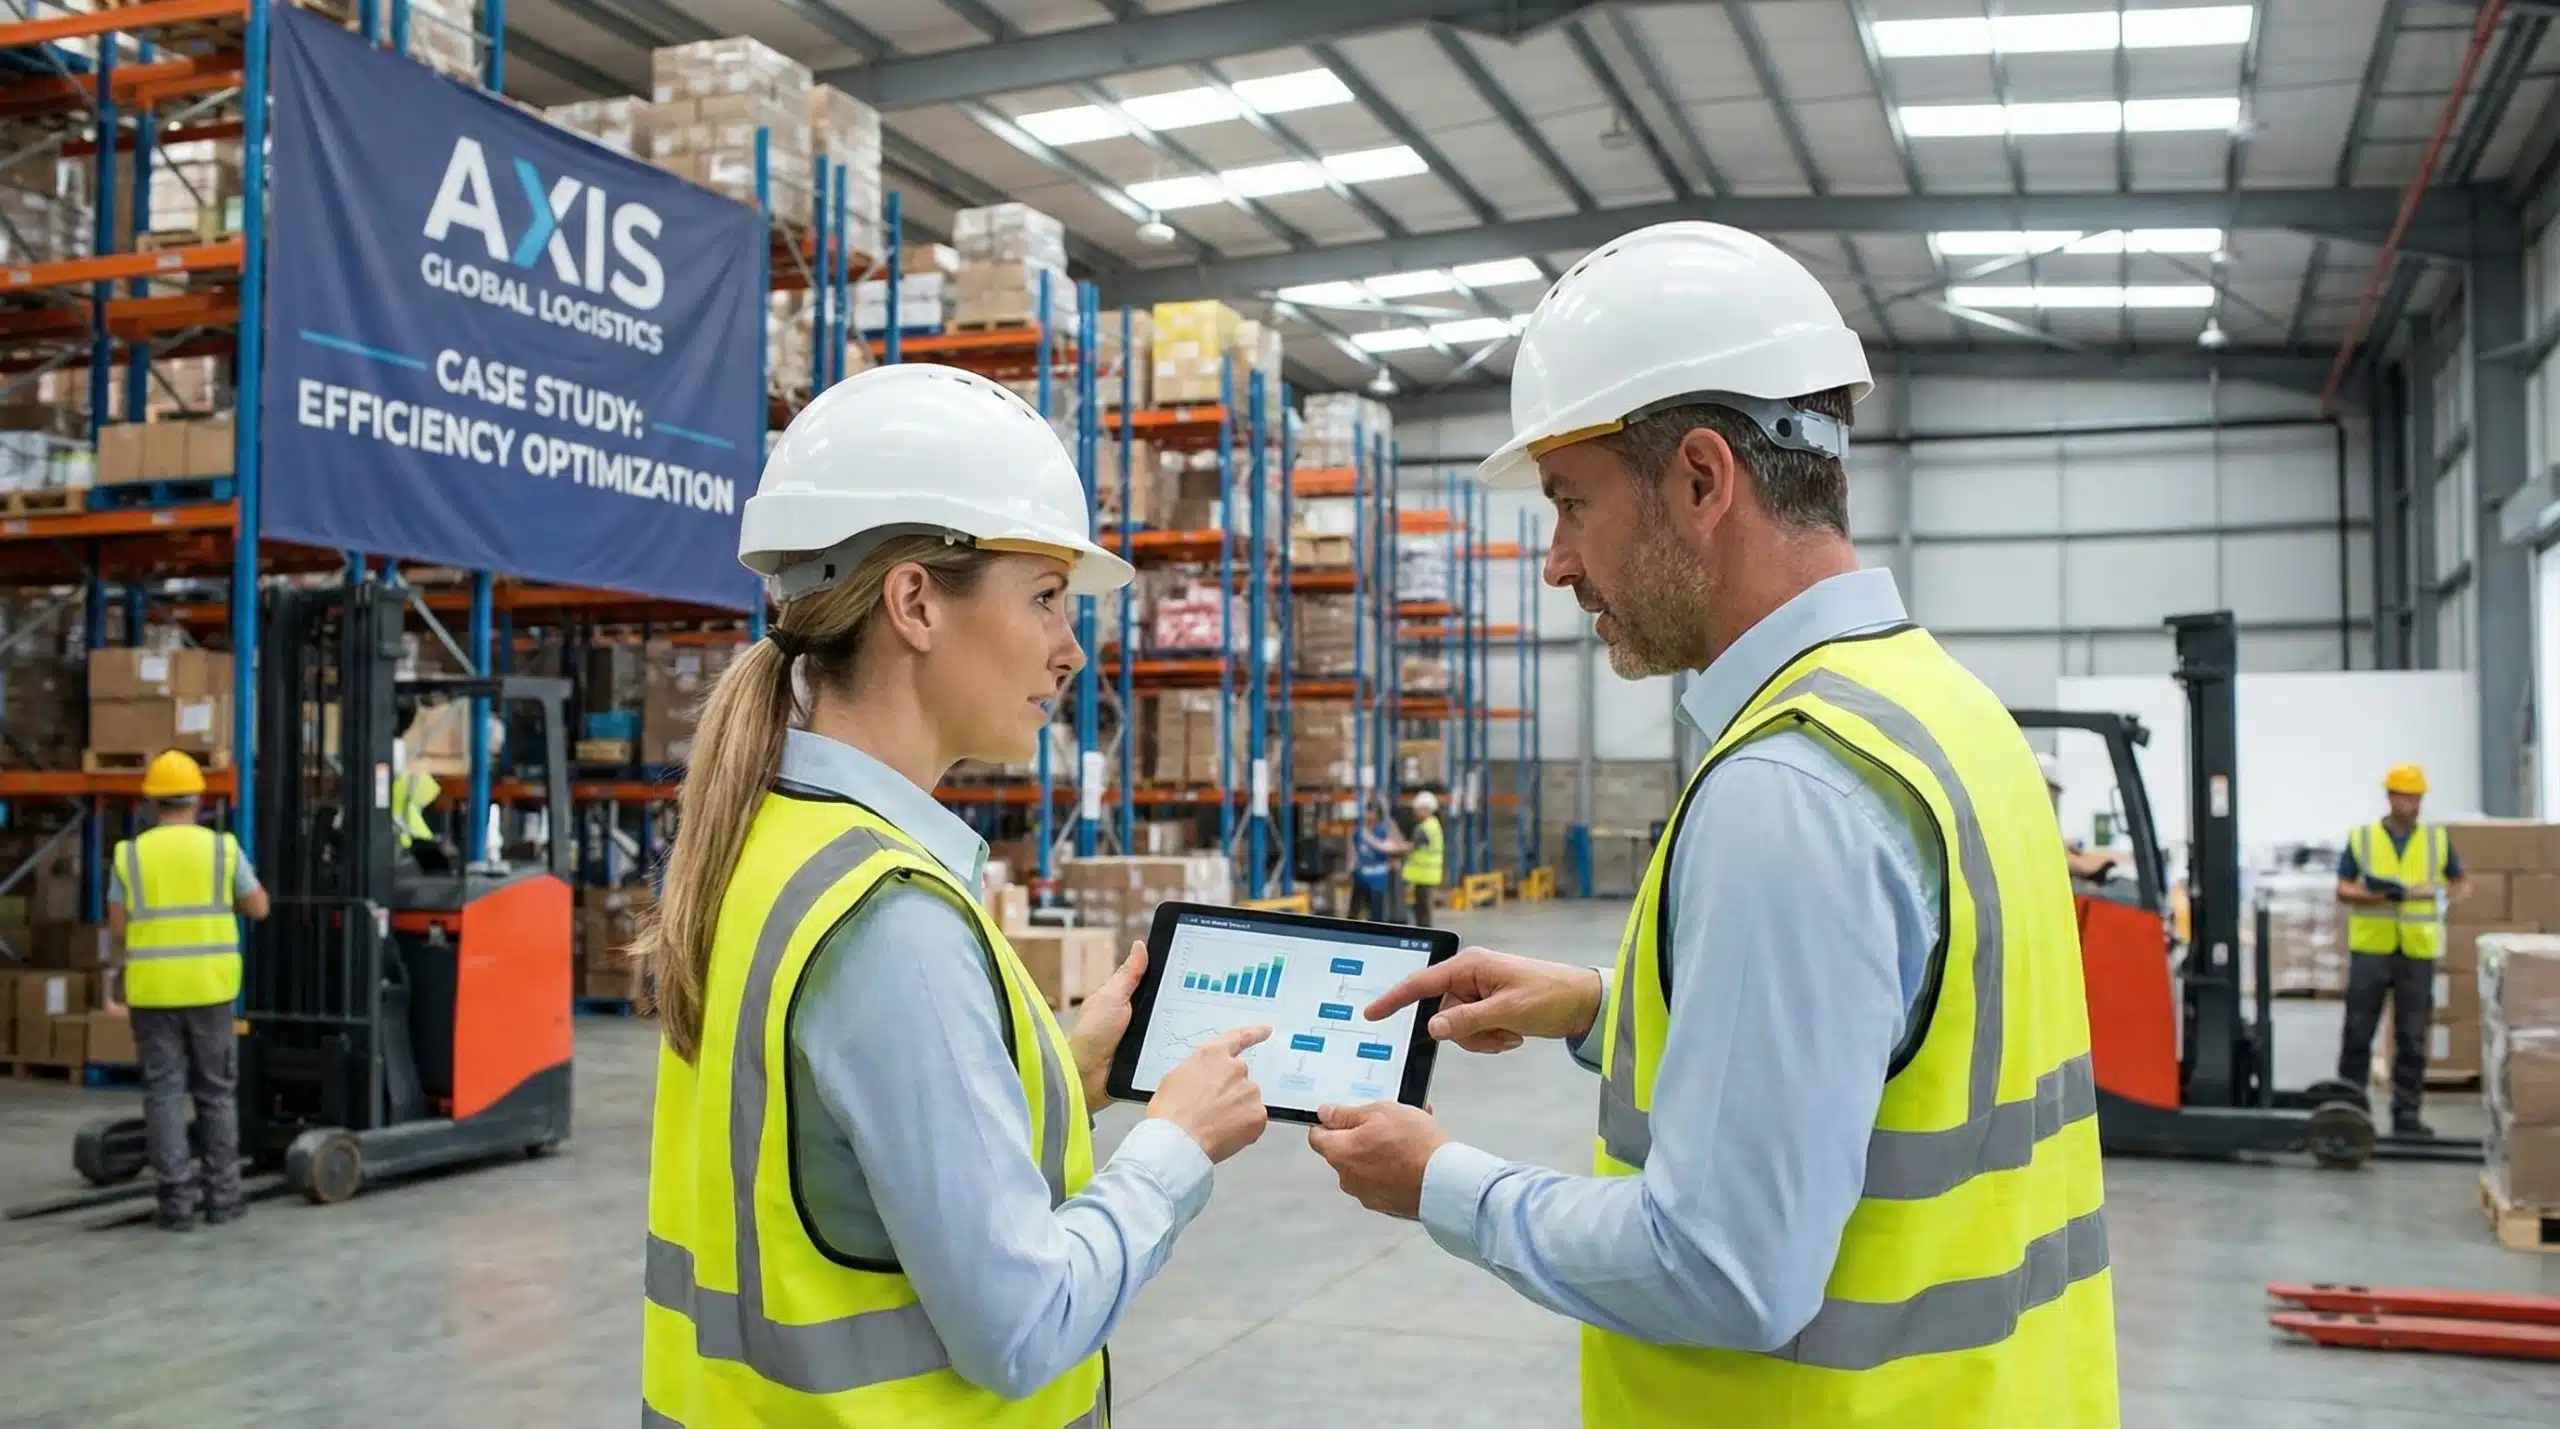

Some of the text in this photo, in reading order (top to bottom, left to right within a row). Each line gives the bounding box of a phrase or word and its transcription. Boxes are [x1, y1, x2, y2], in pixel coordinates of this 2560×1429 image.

[422, 136, 666, 311] AXIS
[421, 252, 665, 355] GLOBAL LOGISTICS
[298, 380, 735, 515] EFFICIENCY OPTIMIZATION
[436, 349, 644, 439] CASE STUDY:
